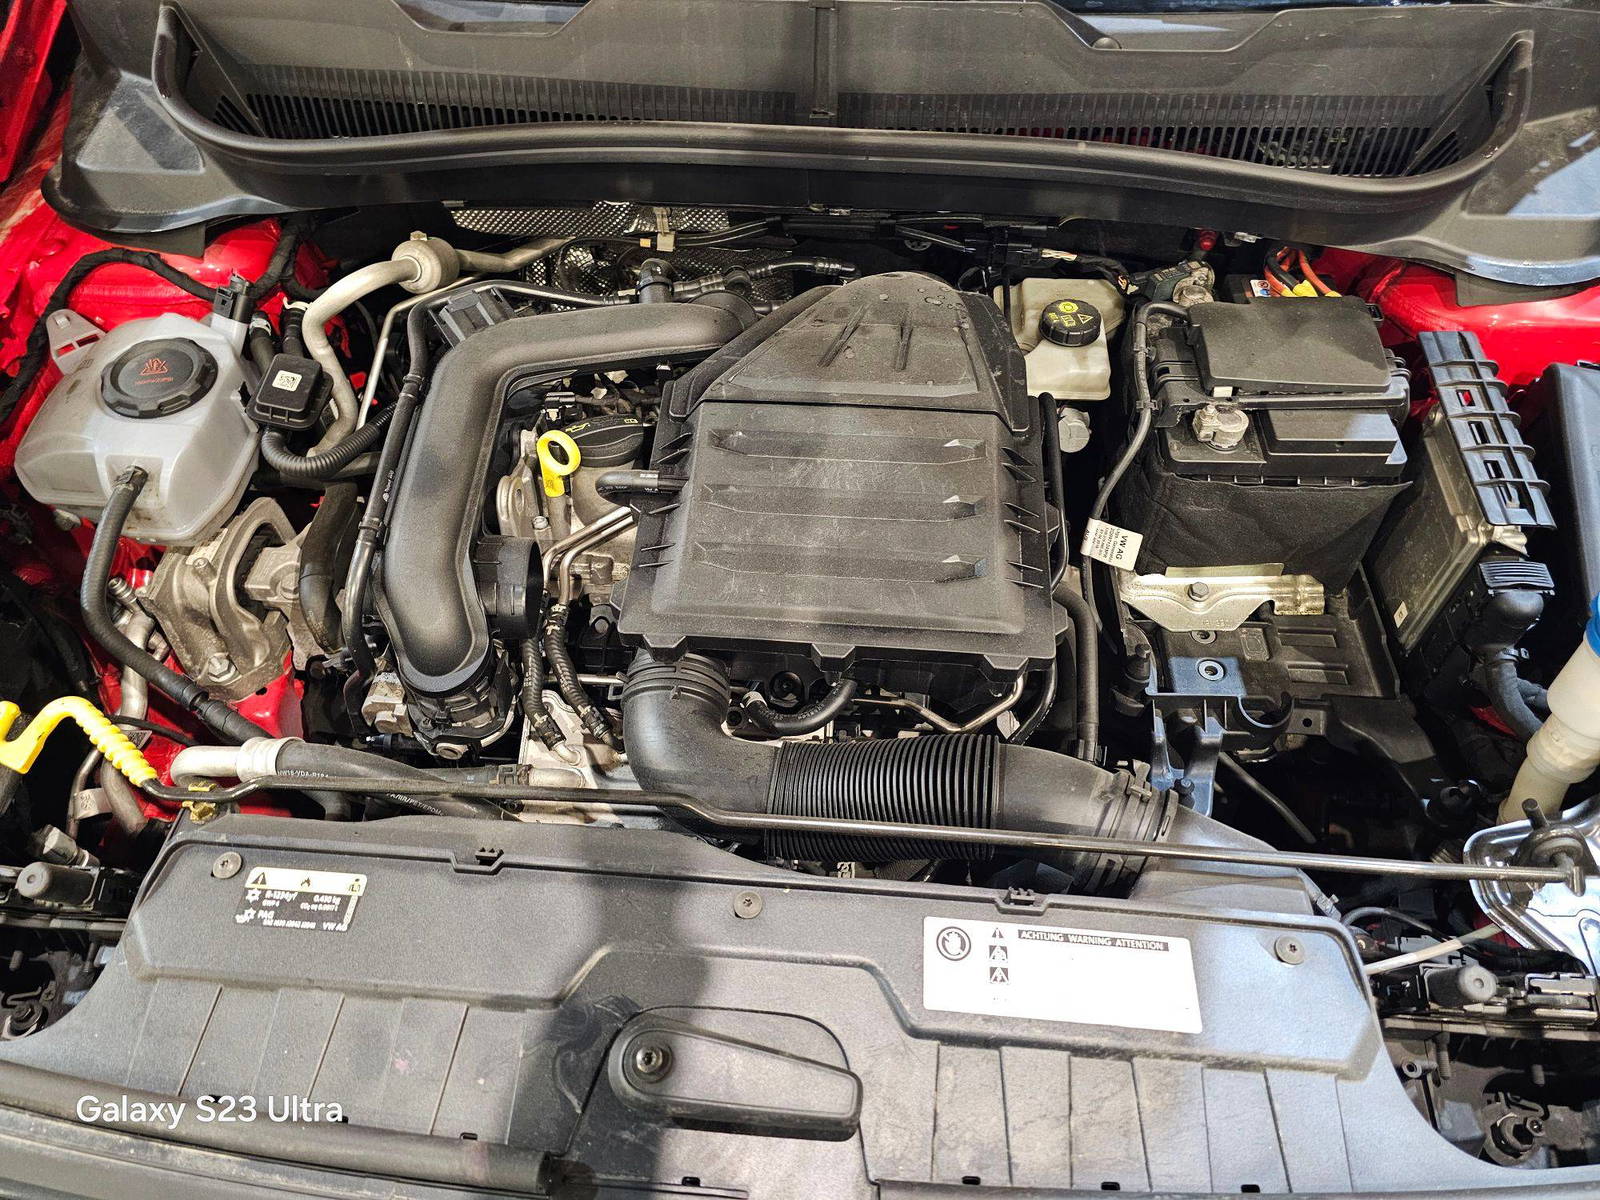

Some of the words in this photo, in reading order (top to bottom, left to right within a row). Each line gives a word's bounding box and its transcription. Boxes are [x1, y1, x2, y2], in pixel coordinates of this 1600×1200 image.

[1119, 535, 1128, 548] VW
[1116, 548, 1123, 560] AG
[322, 922, 336, 931] VW
[1020, 930, 1064, 942] ACHTUNG
[1068, 934, 1112, 946] WARNING
[1115, 938, 1164, 951] ATTENTION
